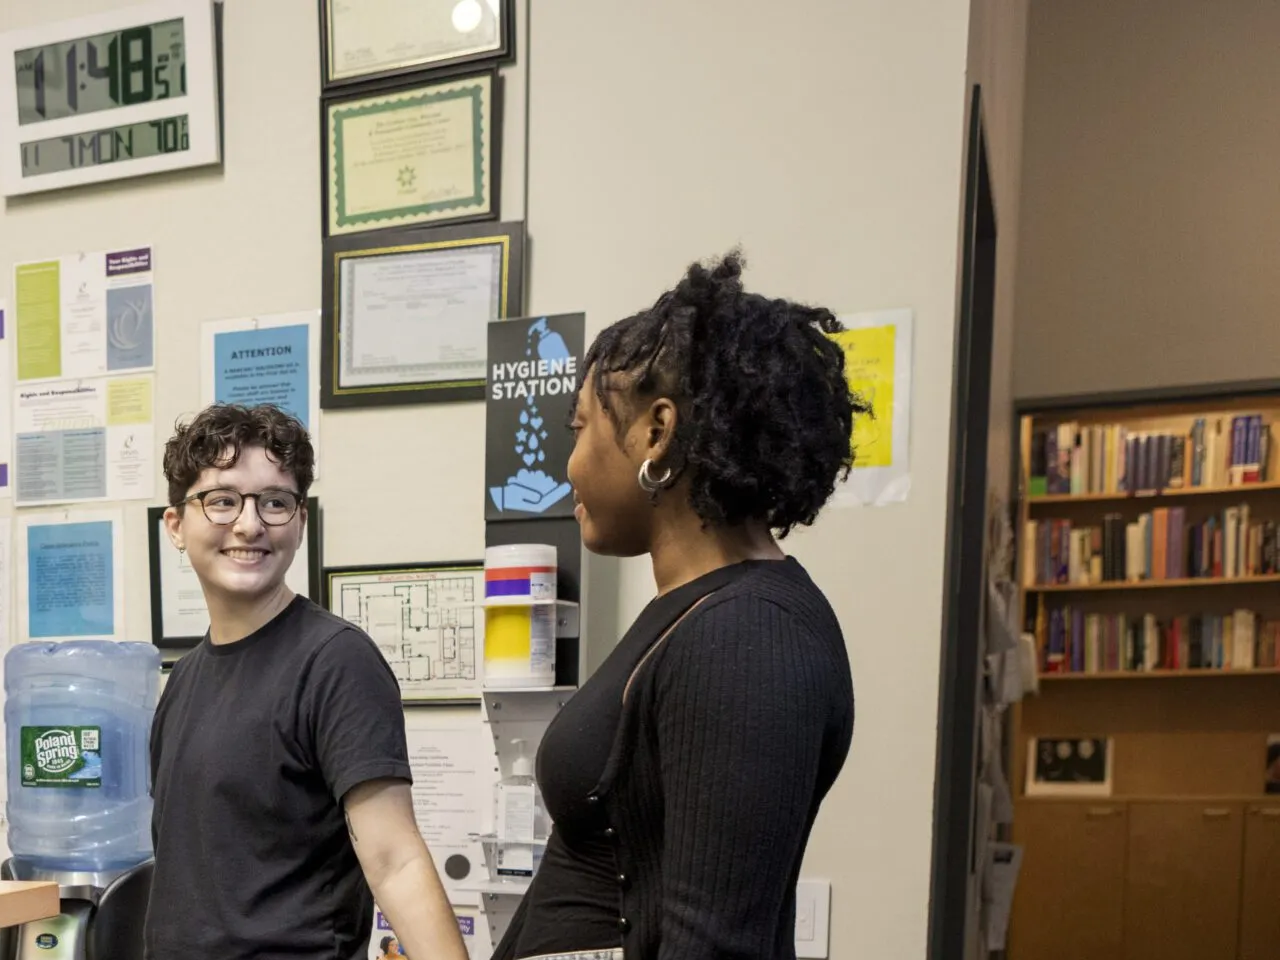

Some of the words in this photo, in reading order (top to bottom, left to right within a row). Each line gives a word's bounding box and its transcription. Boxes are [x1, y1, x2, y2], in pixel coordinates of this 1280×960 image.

[34, 27, 153, 118] 11:48
[78, 128, 134, 168] MON
[230, 345, 293, 360] ATTENTION
[492, 356, 577, 381] HYGIENE
[51, 387, 97, 396] Responsibilities
[492, 376, 577, 401] STATION
[35, 730, 77, 754] Poland
[37, 745, 78, 767] Spring
